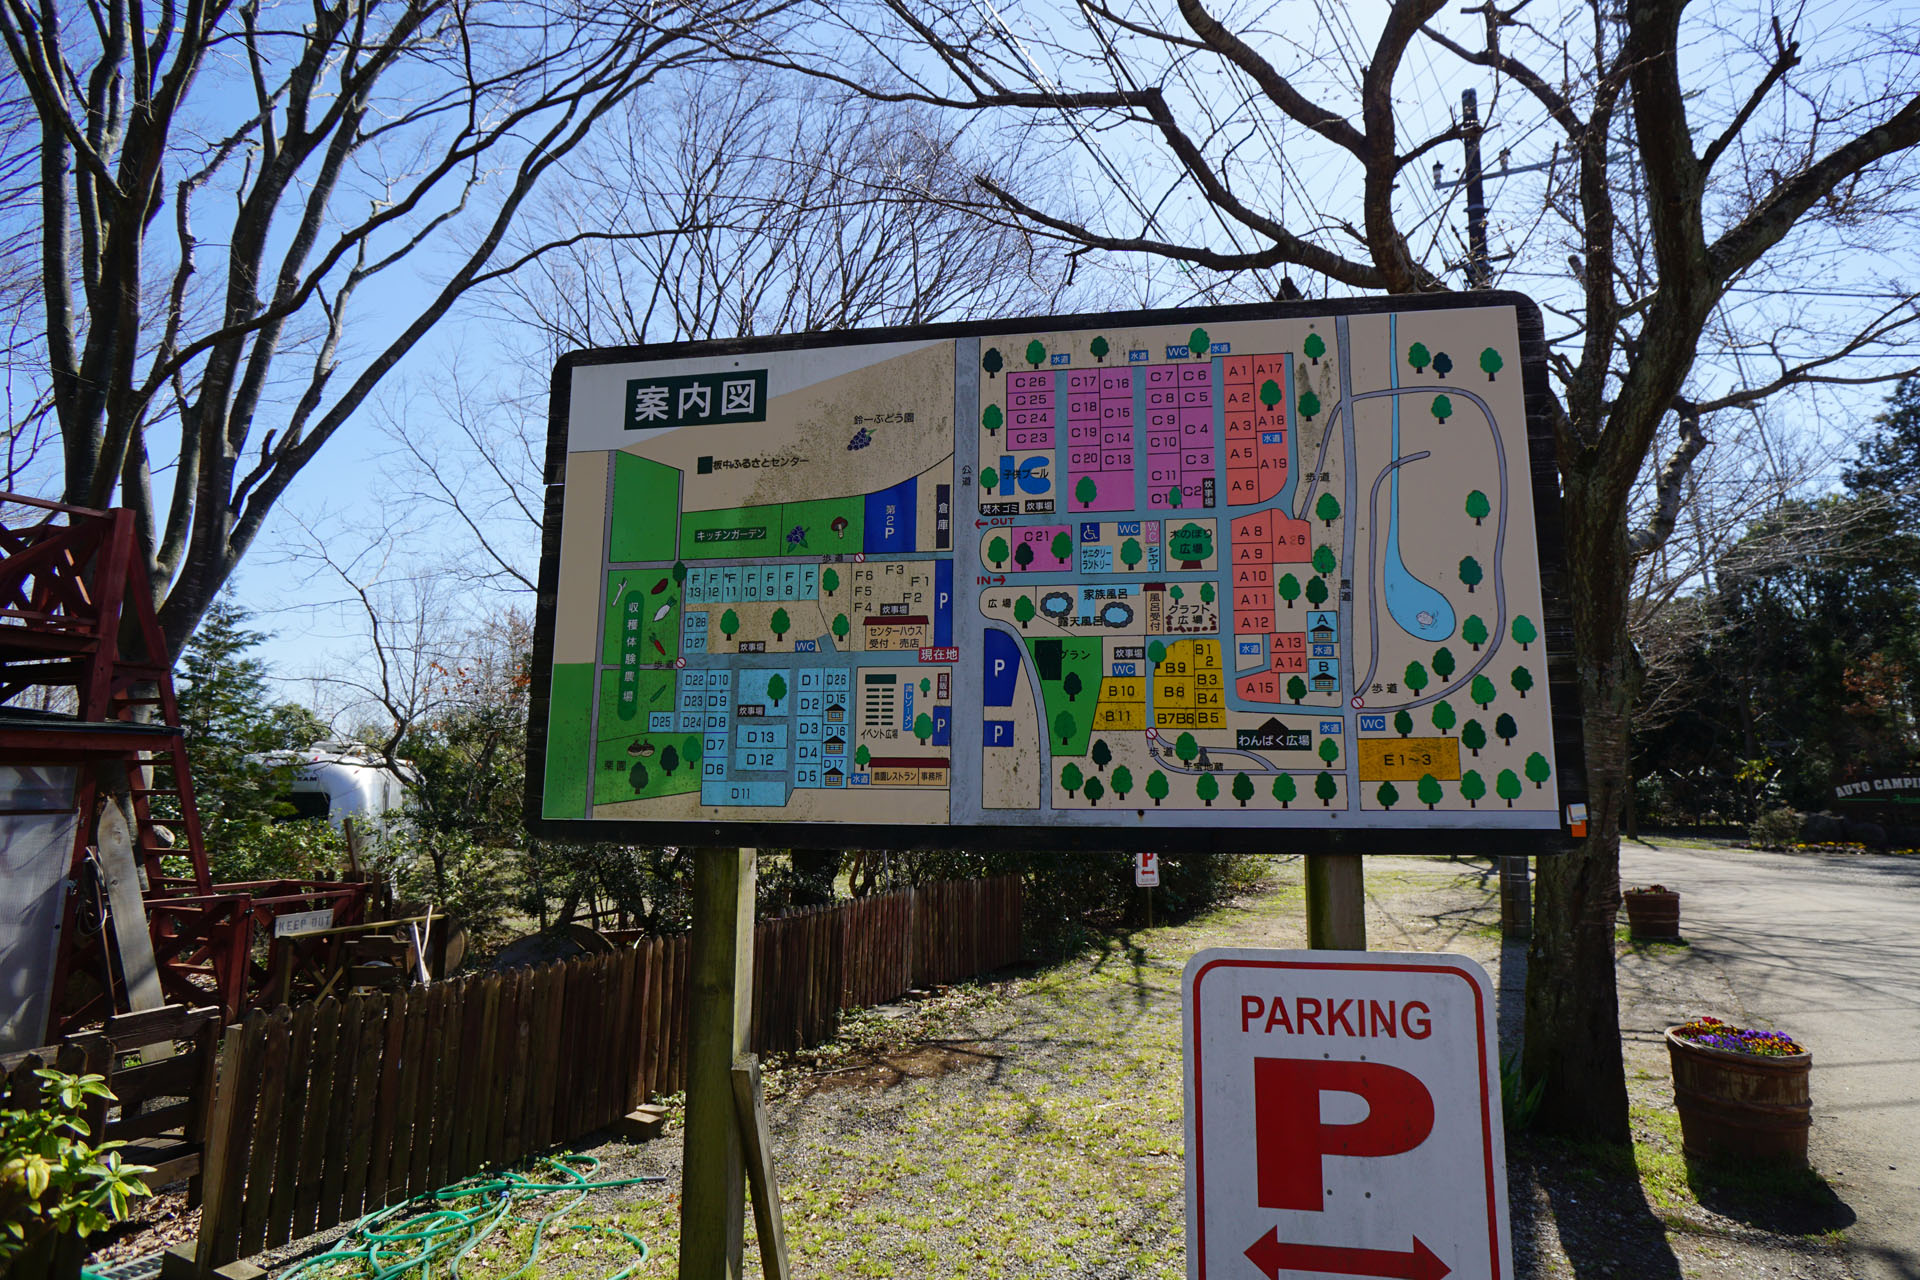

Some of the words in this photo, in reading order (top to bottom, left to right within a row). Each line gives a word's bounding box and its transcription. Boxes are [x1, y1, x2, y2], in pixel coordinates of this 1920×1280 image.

[1130, 351, 1148, 361] 水道
[1167, 346, 1188, 356] WC
[1053, 355, 1069, 364] 水道
[634, 379, 756, 422] 案内図
[1263, 433, 1281, 443] 水道
[1183, 486, 1202, 497] C2
[937, 502, 949, 531] 倉庫
[990, 517, 1015, 525] OUT
[1120, 523, 1140, 534] WC
[696, 529, 766, 541] キッチンガーデン
[1082, 548, 1111, 559] サニタリー
[886, 565, 904, 575] F3
[1082, 560, 1111, 570] ランドリー
[855, 571, 873, 581] F6
[977, 576, 991, 585] IN
[911, 577, 929, 587] F1
[855, 587, 872, 597] F5
[1083, 588, 1128, 600] 家族風呂
[903, 593, 922, 603] F2
[939, 594, 949, 610] P
[988, 598, 1011, 608] 広場
[854, 603, 872, 613] F4
[1150, 593, 1160, 631] 風呂受付
[1169, 605, 1210, 615] クラフト
[1177, 615, 1203, 625] 広場
[1316, 614, 1328, 625] A
[869, 626, 923, 636] センターハウス
[795, 641, 815, 650] WC
[1241, 643, 1260, 654] 水道
[1314, 645, 1333, 655] 水道
[920, 649, 958, 661] 現在地
[994, 659, 1006, 679] P
[1113, 664, 1135, 675] WC
[1165, 663, 1186, 673] B9
[1319, 662, 1329, 672] B
[685, 675, 704, 686] D22
[709, 674, 728, 685] D10
[826, 674, 846, 685] D26
[1197, 674, 1216, 685] B3
[1371, 683, 1397, 694] 歩道
[684, 696, 703, 706] D23
[708, 696, 727, 706] D9
[1198, 693, 1217, 704] B4
[652, 717, 671, 728] D25
[683, 717, 701, 728] D24
[707, 716, 726, 727] D8
[1198, 712, 1219, 723] B5
[937, 718, 946, 734] P
[1321, 724, 1340, 733] 水道
[1362, 718, 1384, 729] WC
[993, 725, 1004, 744] P
[706, 740, 724, 750] D7
[1238, 735, 1310, 747] わんぱく広場
[705, 764, 724, 775] D6
[852, 774, 869, 784] 水道
[1835, 781, 1870, 798] AUTO
[278, 919, 307, 932] KEEP
[311, 915, 331, 927] OUT
[1240, 995, 1432, 1041] PARKING
[1254, 1056, 1435, 1212] P
